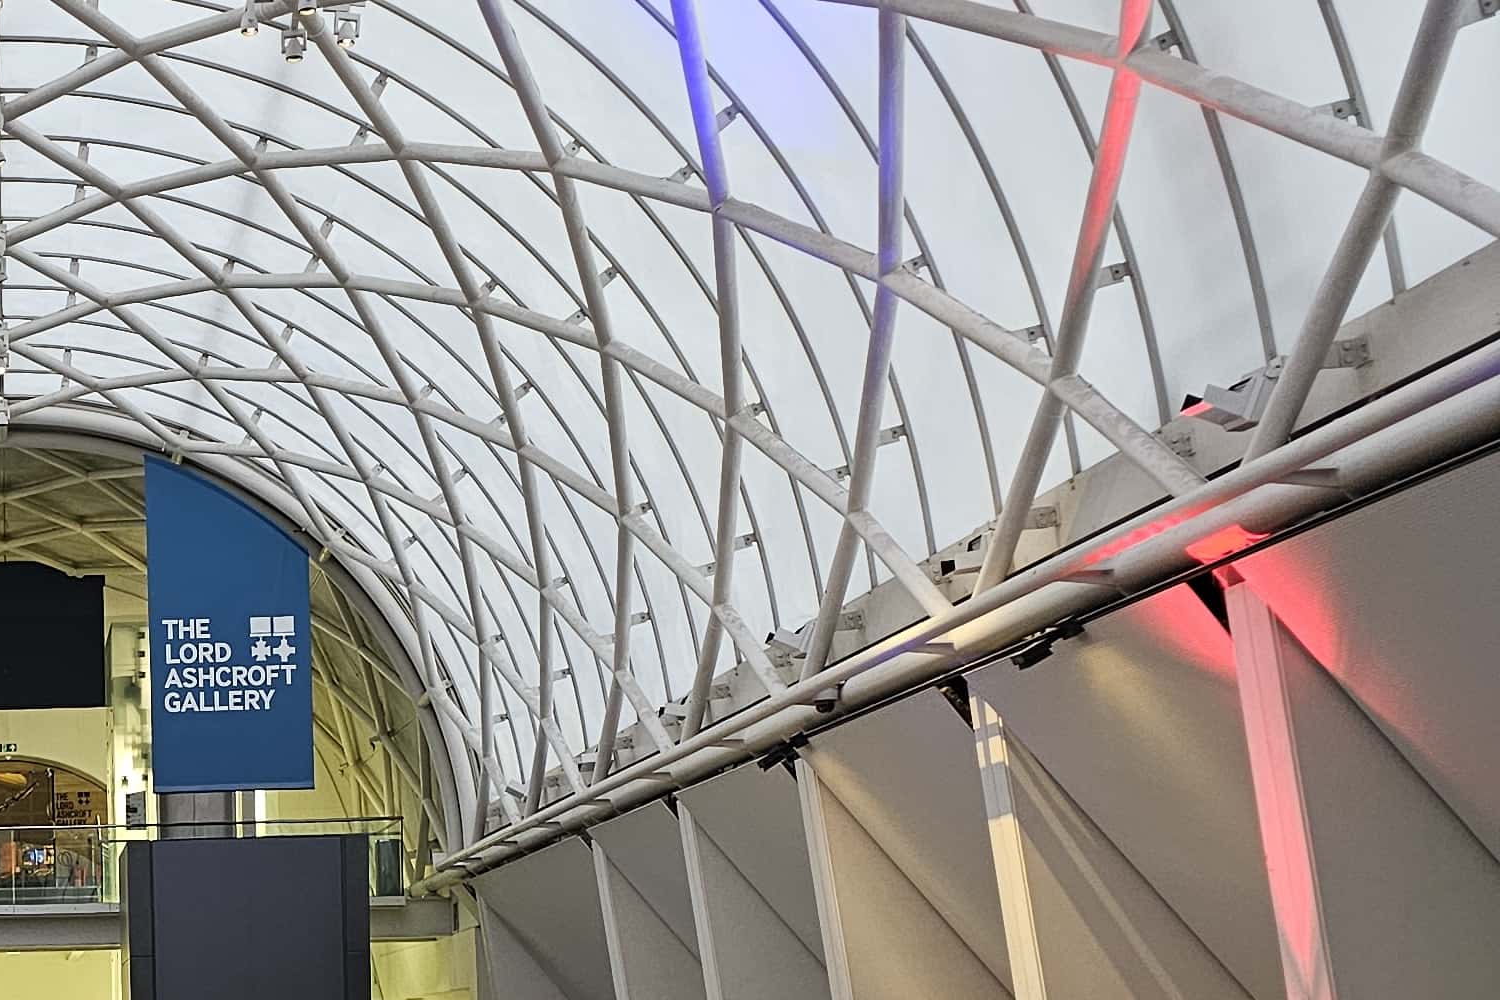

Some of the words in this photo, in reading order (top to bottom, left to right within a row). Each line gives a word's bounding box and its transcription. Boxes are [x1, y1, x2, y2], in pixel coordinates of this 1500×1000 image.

[162, 618, 211, 639] THE
[165, 642, 232, 664] LORD
[164, 665, 297, 688] ASHCROFT
[164, 689, 276, 712] GALLERY
[56, 792, 68, 801] THE
[56, 801, 74, 809] LORD
[56, 810, 92, 818] ASHCROFT
